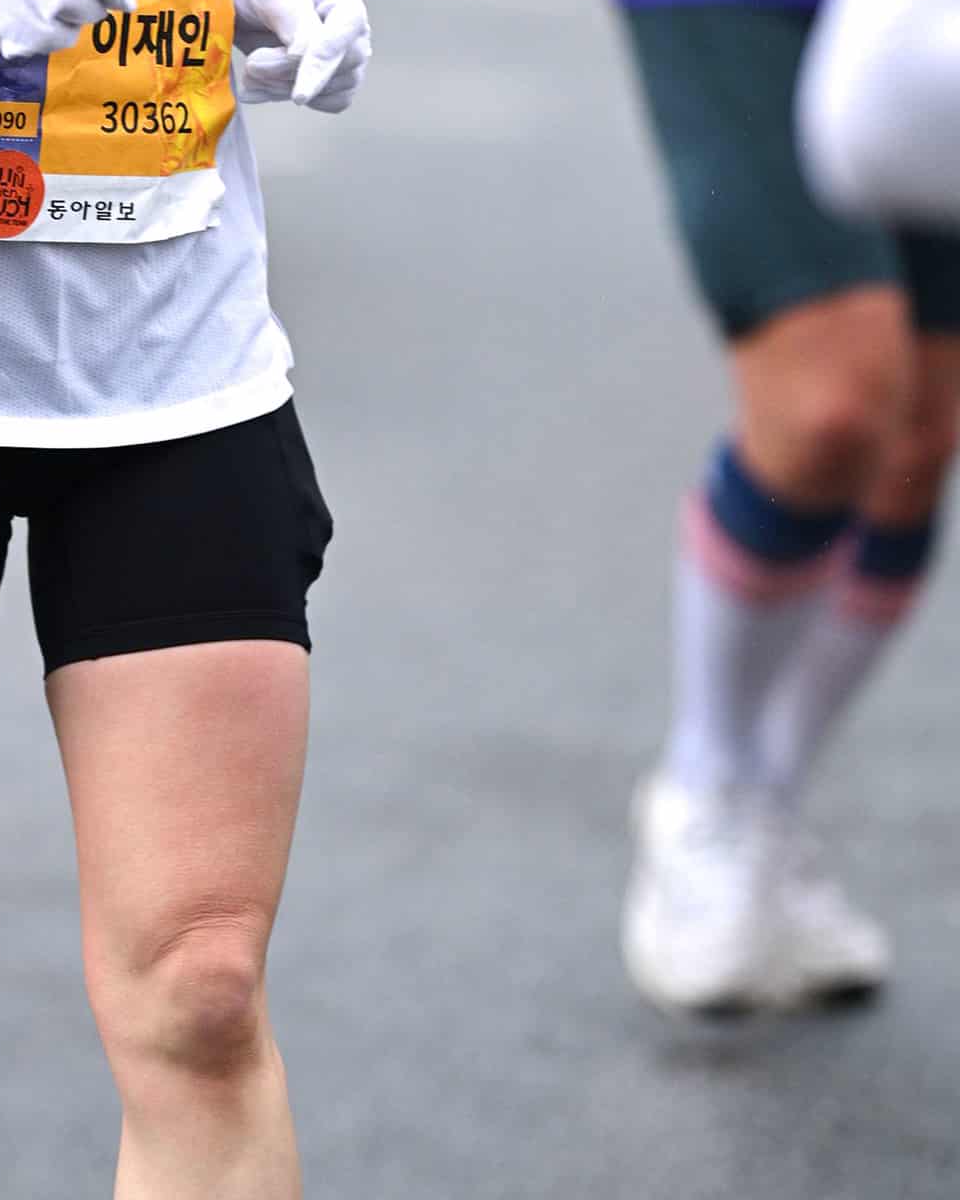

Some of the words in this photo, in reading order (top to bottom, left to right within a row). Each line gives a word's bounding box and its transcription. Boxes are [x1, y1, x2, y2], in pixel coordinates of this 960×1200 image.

[92, 10, 210, 68] 이재인
[100, 100, 193, 135] 30362
[47, 199, 137, 221] 동아일보
